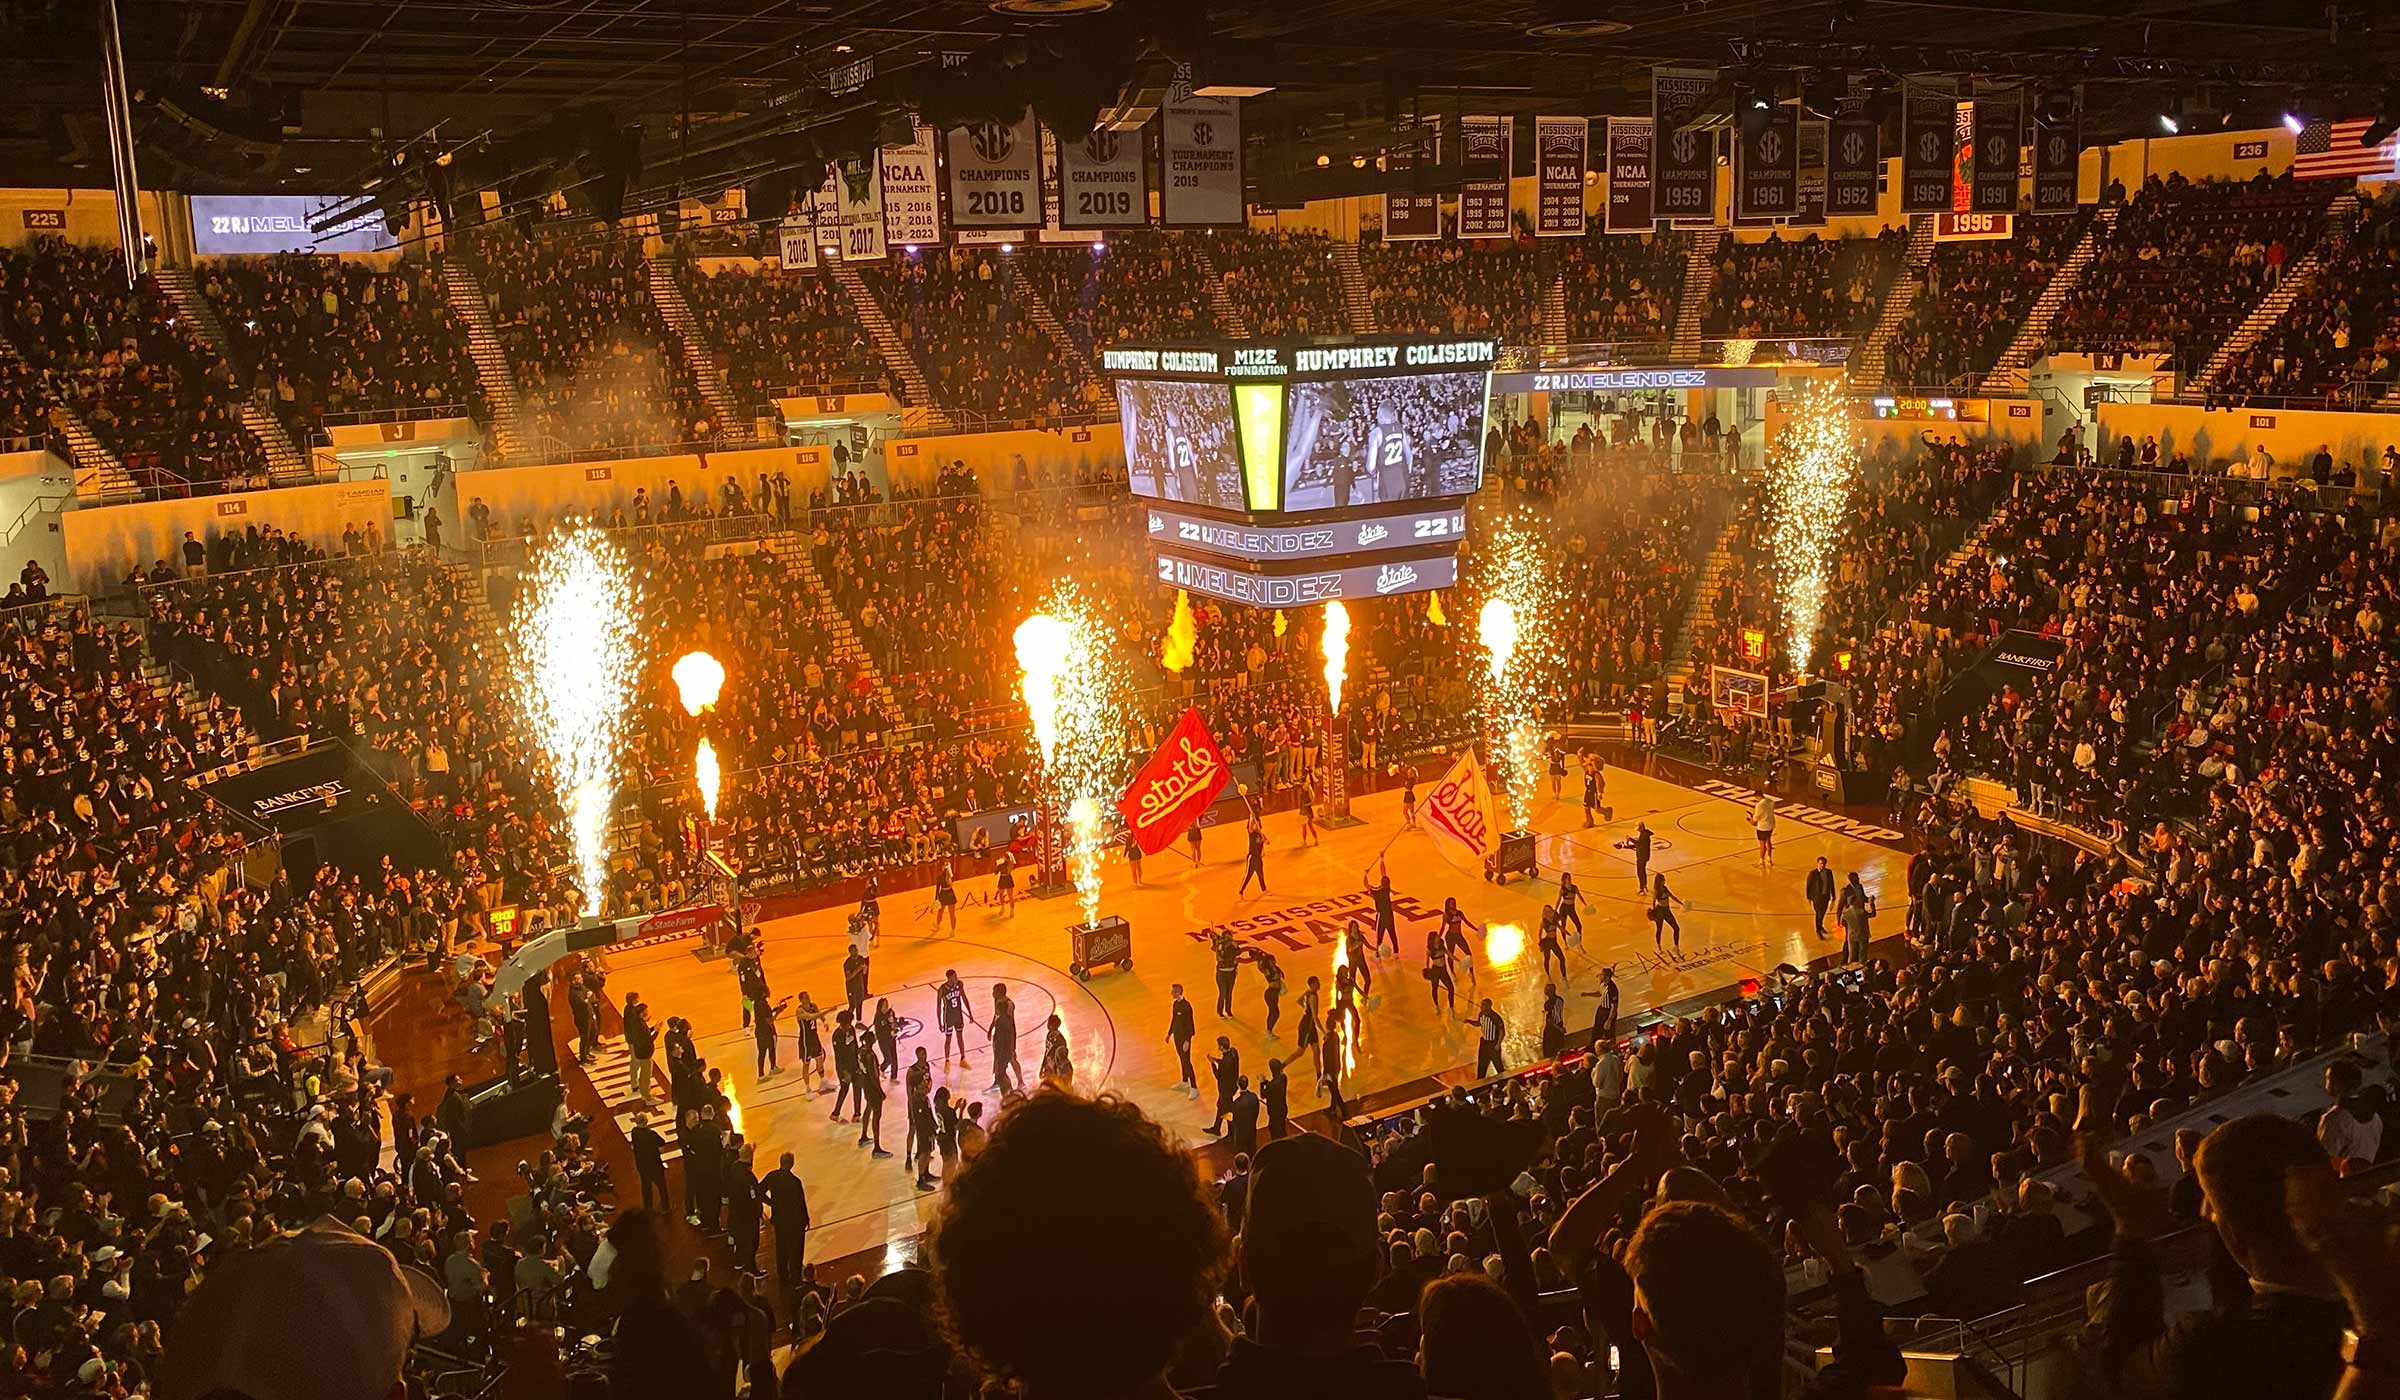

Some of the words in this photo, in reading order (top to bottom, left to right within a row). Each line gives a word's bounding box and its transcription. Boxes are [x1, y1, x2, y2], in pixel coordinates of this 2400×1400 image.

[829, 59, 875, 92] MISSISSIPPI
[1172, 151, 1234, 160] TOURNAMENT
[2239, 145, 2263, 157] 236
[1173, 161, 1234, 172] CHAMPIONS
[1546, 165, 1578, 180] NCAA
[1616, 164, 1648, 179] NCAA
[959, 169, 1031, 181] CHAMPIONS
[1071, 171, 1137, 183] CHAMPIONS
[1173, 175, 1199, 188] 2019
[1664, 187, 1703, 206] 1959
[1752, 186, 1786, 206] 1961
[1836, 186, 1868, 205] 1962
[1912, 184, 1946, 202] 1963
[1980, 187, 2008, 204] 1991
[907, 203, 933, 213] 2016
[967, 191, 1025, 215] 2018
[1079, 192, 1131, 215] 2019
[29, 213, 60, 226] 225
[211, 217, 229, 233] 22
[231, 217, 250, 236] RJ
[909, 217, 934, 227] 2018
[1952, 214, 1994, 233] 1996
[850, 228, 874, 256] 2017
[910, 231, 934, 240] 2023
[787, 239, 809, 264] 2018
[1103, 350, 1159, 371] HUMPHREY
[1161, 351, 1218, 373] COLISEUM
[1234, 349, 1278, 366] MIZE
[1296, 346, 1400, 372] HUMPHREY
[1406, 341, 1494, 366] COLISEUM
[2102, 355, 2115, 369] N
[1224, 365, 1288, 376] FOUNDATION
[1534, 375, 1550, 391] 22
[1551, 375, 1569, 390] RJ
[1570, 371, 1706, 389] MELENDEZ
[826, 399, 837, 411] K
[1900, 400, 1927, 410] 20:00
[2012, 408, 2027, 416] 120
[2255, 418, 2270, 427] 101
[393, 424, 404, 440] J
[1385, 440, 1404, 466] 22
[591, 469, 606, 479] 115
[223, 502, 240, 514] 114
[1179, 521, 1200, 541] 22
[1212, 527, 1334, 552] MELENDEZ
[1358, 523, 1388, 546] State
[1414, 517, 1448, 538] 22
[1176, 561, 1190, 585] RJ
[1190, 565, 1342, 605] MELENDEZ
[1376, 565, 1418, 595] State
[1745, 641, 1761, 657] 30
[1997, 652, 2055, 668] BANKFIRST
[1333, 733, 1344, 763] HAIL
[1333, 768, 1345, 805] STATE
[1773, 803, 1905, 841] HUMP
[490, 909, 516, 923] 20:00
[654, 919, 676, 930] State
[676, 915, 697, 928] Farm
[495, 920, 513, 935] 30
[951, 998, 958, 1008] 5
